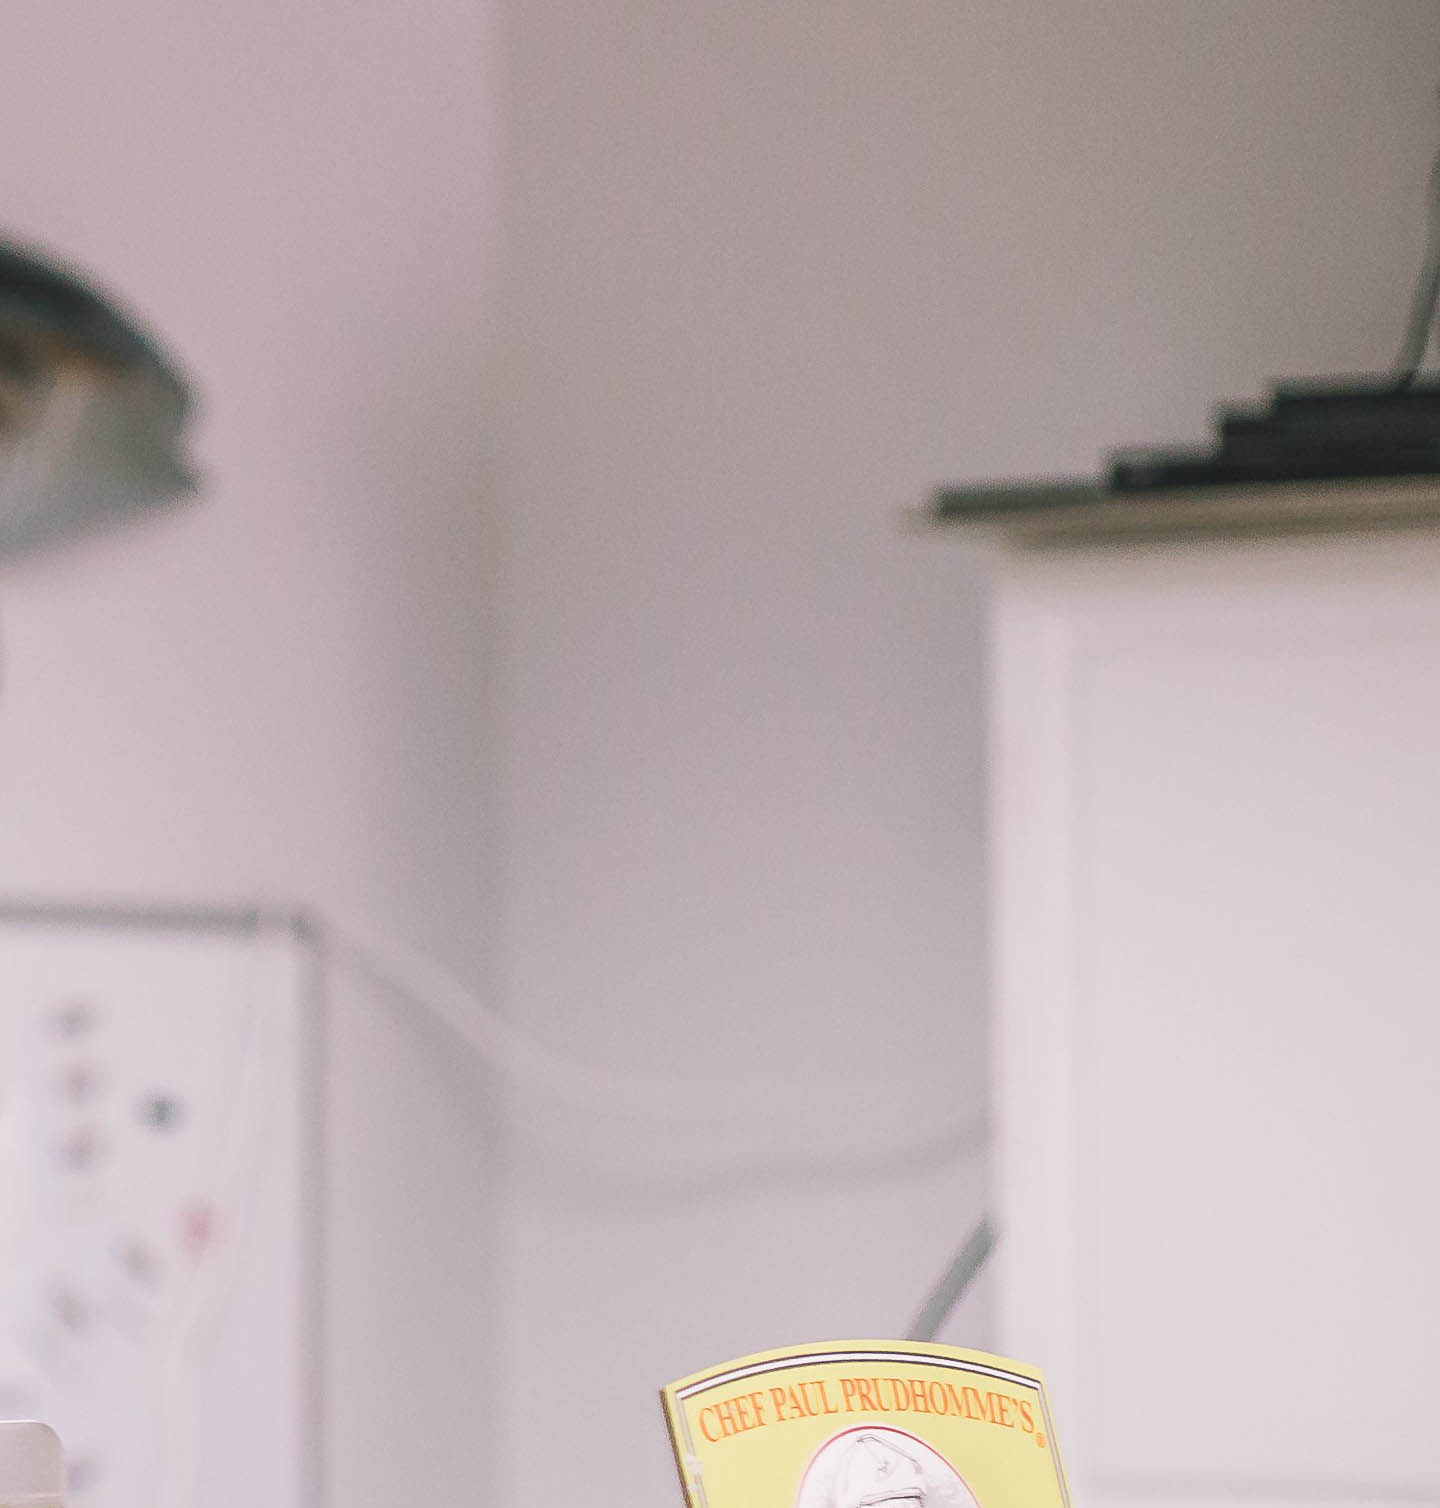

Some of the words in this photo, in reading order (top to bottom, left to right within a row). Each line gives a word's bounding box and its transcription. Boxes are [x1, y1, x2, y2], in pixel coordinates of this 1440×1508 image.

[698, 1391, 767, 1443] CHEF
[768, 1380, 839, 1422] PAUL
[839, 1377, 1037, 1434] PRUDHOMME'S
